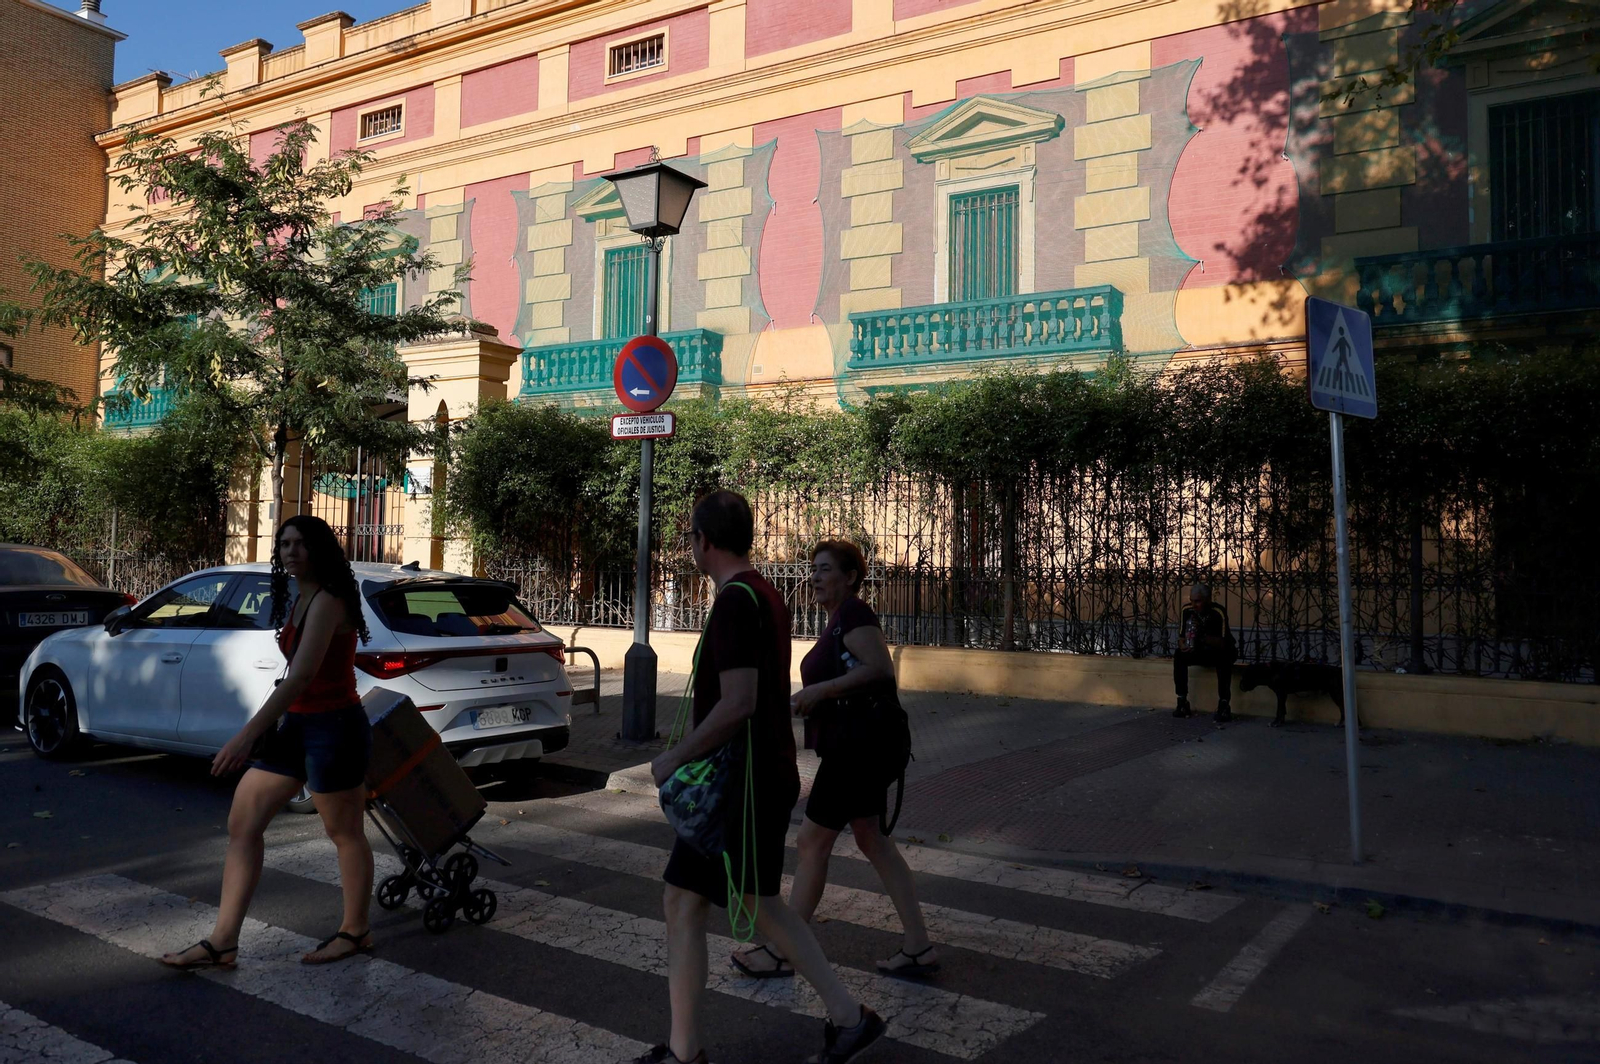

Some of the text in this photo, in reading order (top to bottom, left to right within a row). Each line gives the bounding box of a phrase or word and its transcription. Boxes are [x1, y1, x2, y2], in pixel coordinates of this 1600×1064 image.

[620, 417, 639, 426] EXCEPTO
[617, 425, 665, 435] OFICIALES DE JUSTICIA
[27, 613, 85, 625] 4326 DMJ
